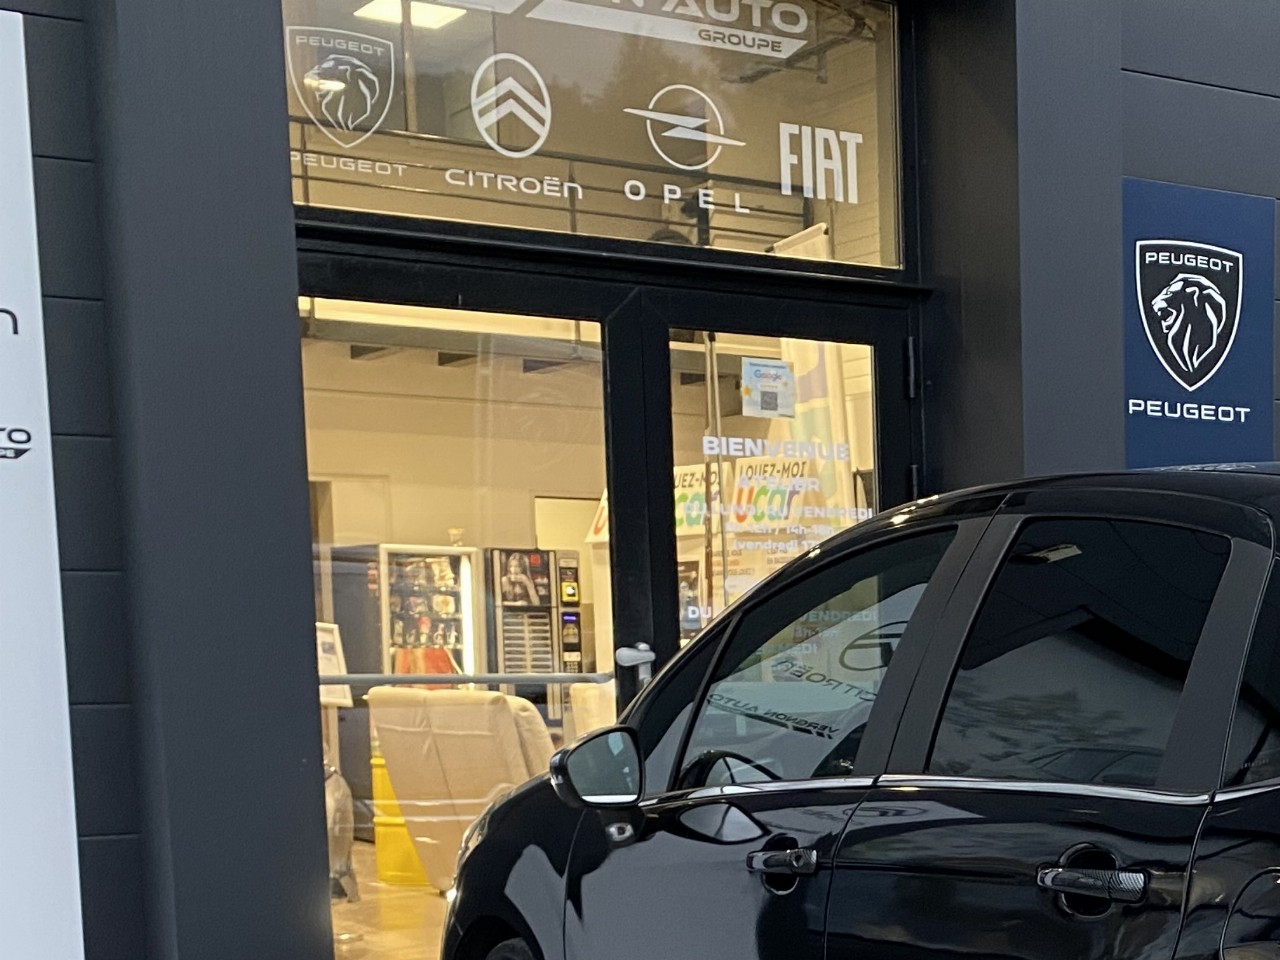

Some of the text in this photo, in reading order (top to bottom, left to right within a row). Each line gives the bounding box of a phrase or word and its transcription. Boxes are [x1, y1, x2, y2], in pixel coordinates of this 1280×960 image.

[295, 35, 385, 57] PEUGEOT
[697, 28, 782, 53] GROUPE
[289, 151, 408, 177] PEUGEOT
[778, 123, 863, 204] FIAT
[624, 180, 750, 214] OPEL
[1145, 251, 1234, 273] PEUGEOT
[1129, 399, 1251, 423] PEUGEOT
[702, 436, 849, 461] BIENVENUE
